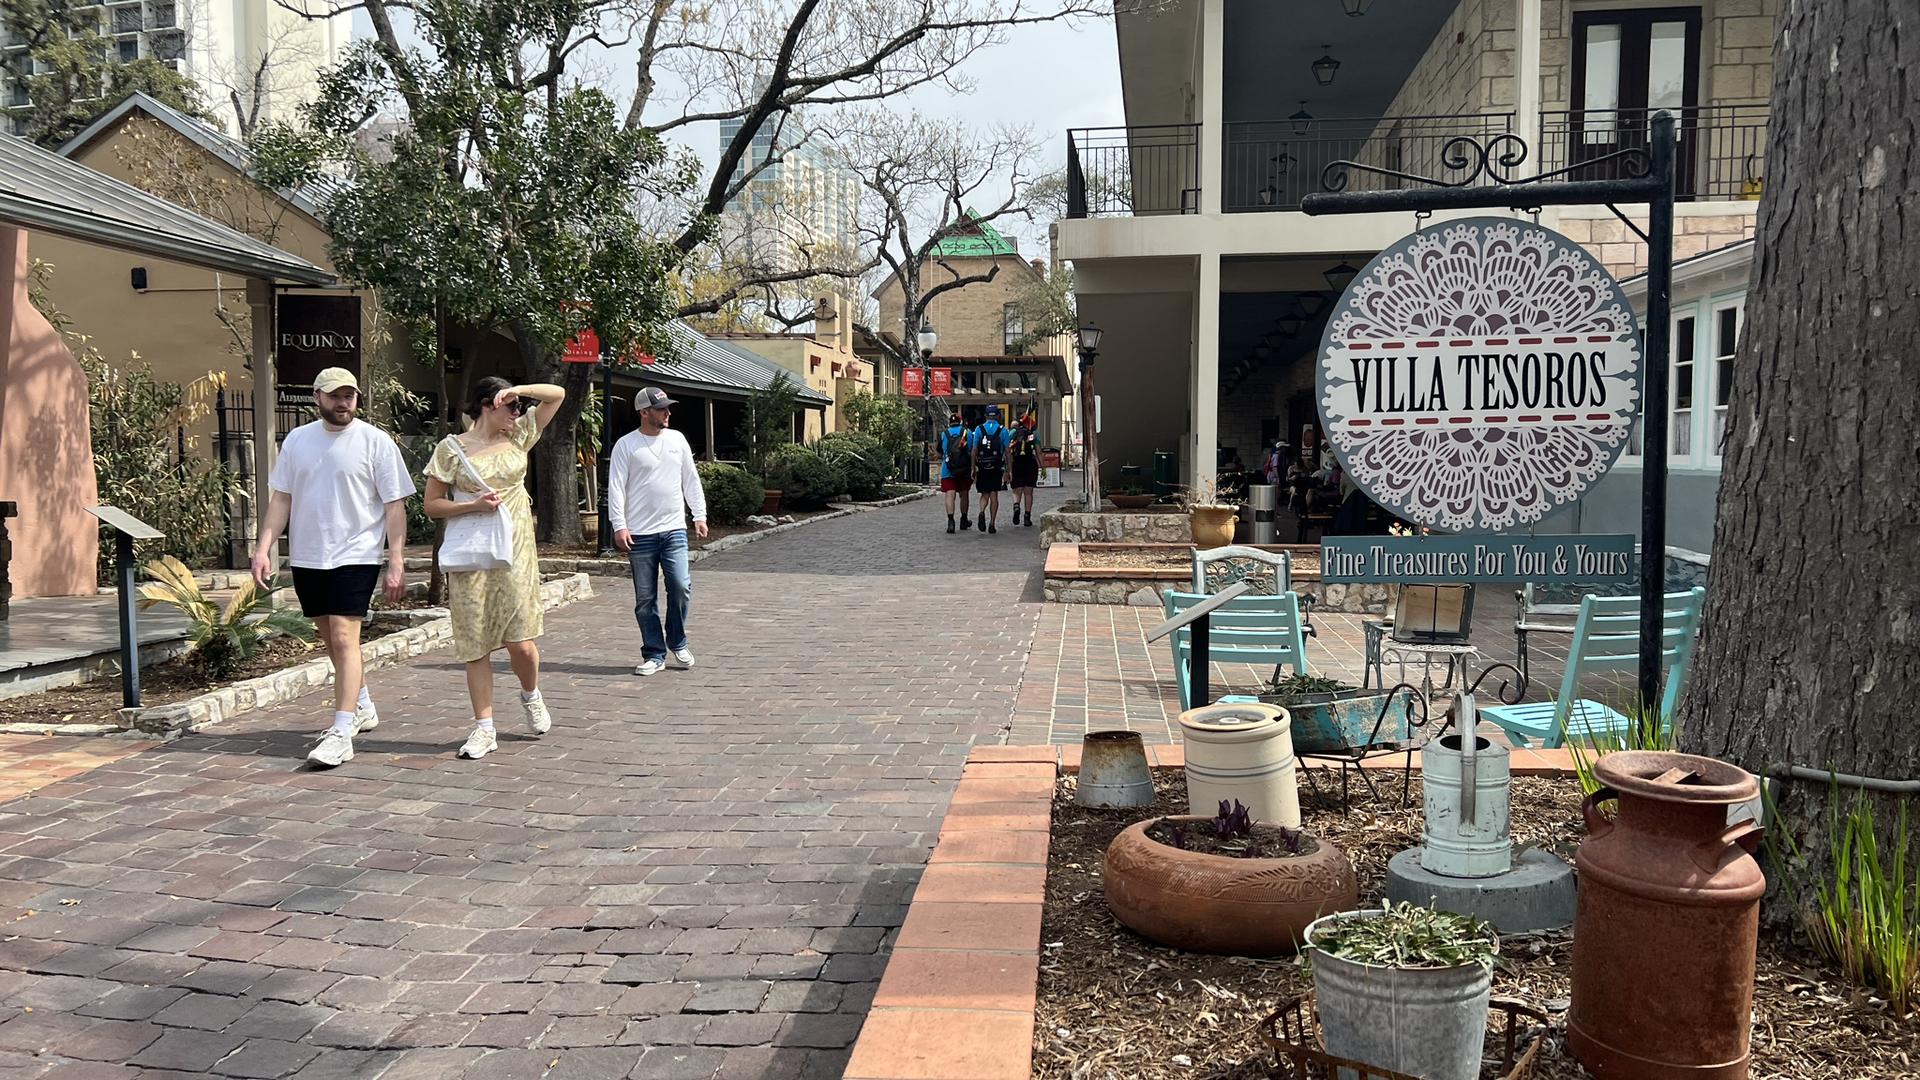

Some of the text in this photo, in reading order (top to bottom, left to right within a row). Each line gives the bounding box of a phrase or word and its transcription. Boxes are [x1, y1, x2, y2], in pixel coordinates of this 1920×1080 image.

[282, 331, 356, 352] EQUINOX
[1350, 350, 1608, 413] VILLA TESOROS
[1323, 543, 1630, 577] Fine Treasures For You & Yours
